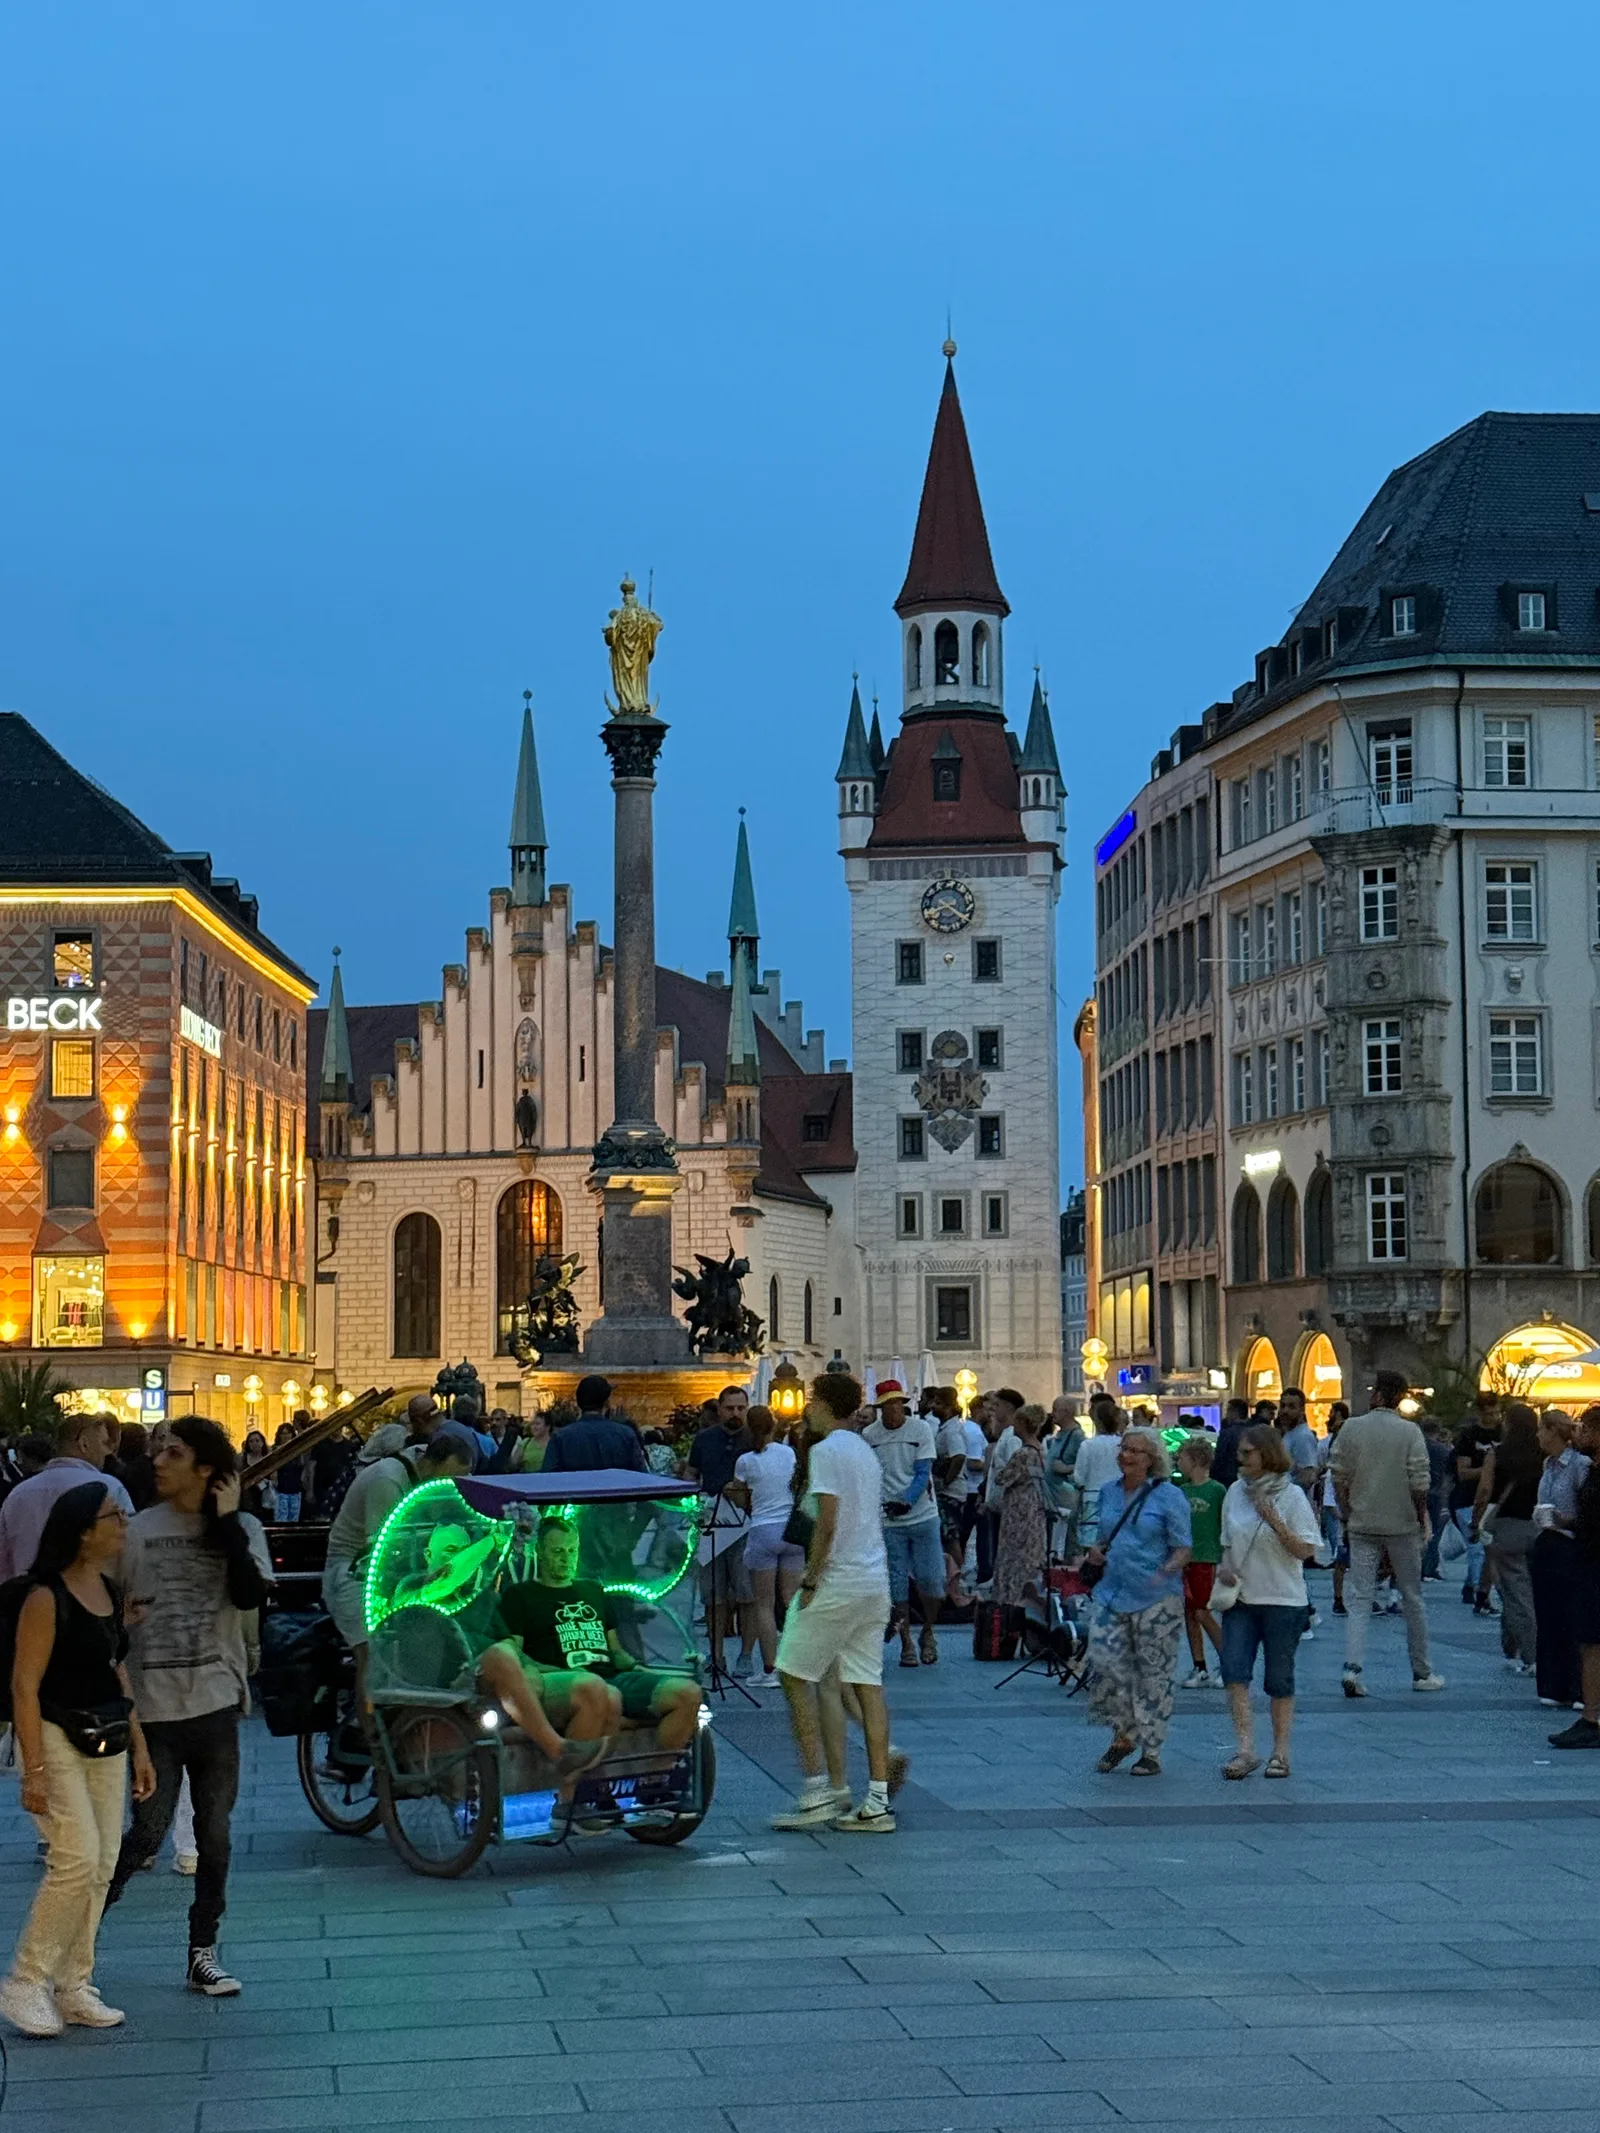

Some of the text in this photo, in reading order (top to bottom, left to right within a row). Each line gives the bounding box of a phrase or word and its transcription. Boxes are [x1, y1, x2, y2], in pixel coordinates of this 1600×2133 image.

[7, 998, 102, 1030] BECK
[146, 1370, 162, 1389] S
[146, 1392, 161, 1410] U
